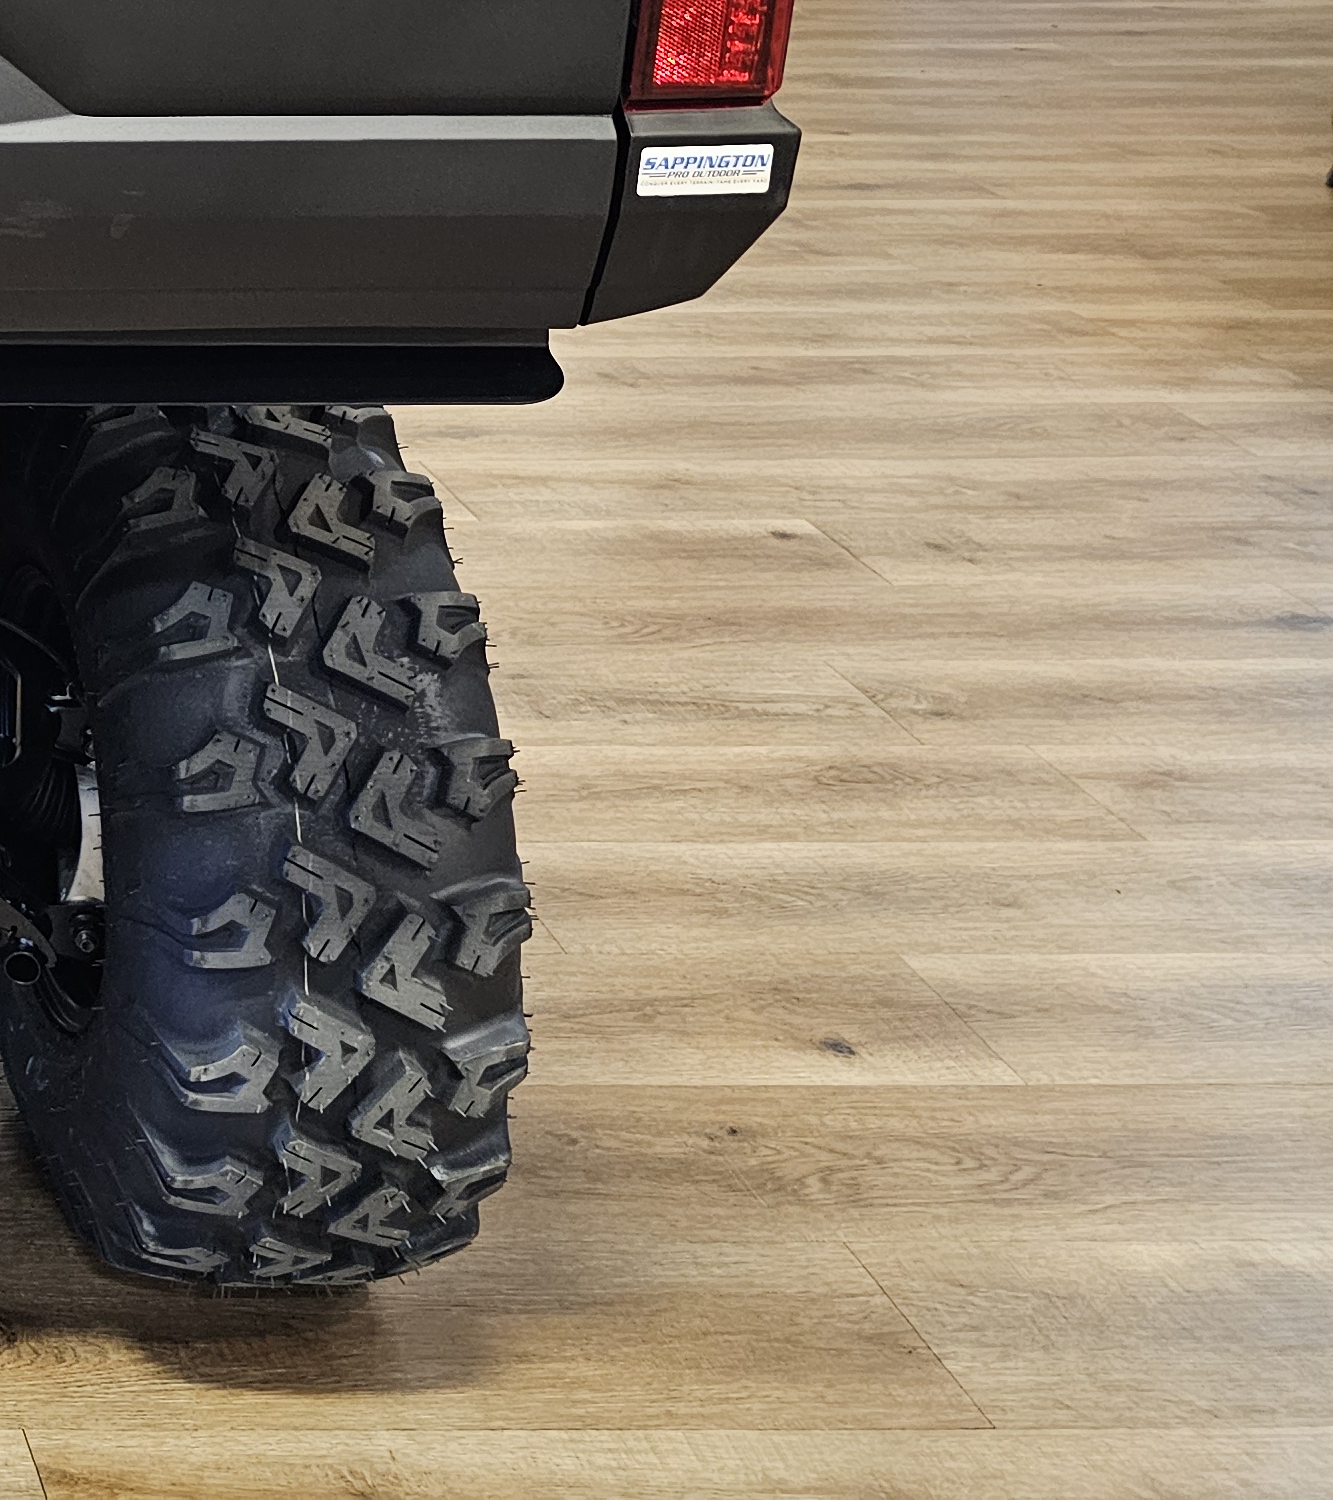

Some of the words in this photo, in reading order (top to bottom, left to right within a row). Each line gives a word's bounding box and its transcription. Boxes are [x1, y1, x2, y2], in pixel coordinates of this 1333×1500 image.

[643, 154, 771, 170] SAPPINGTON
[666, 170, 690, 178] PRO
[692, 169, 741, 178] OUTDOOR
